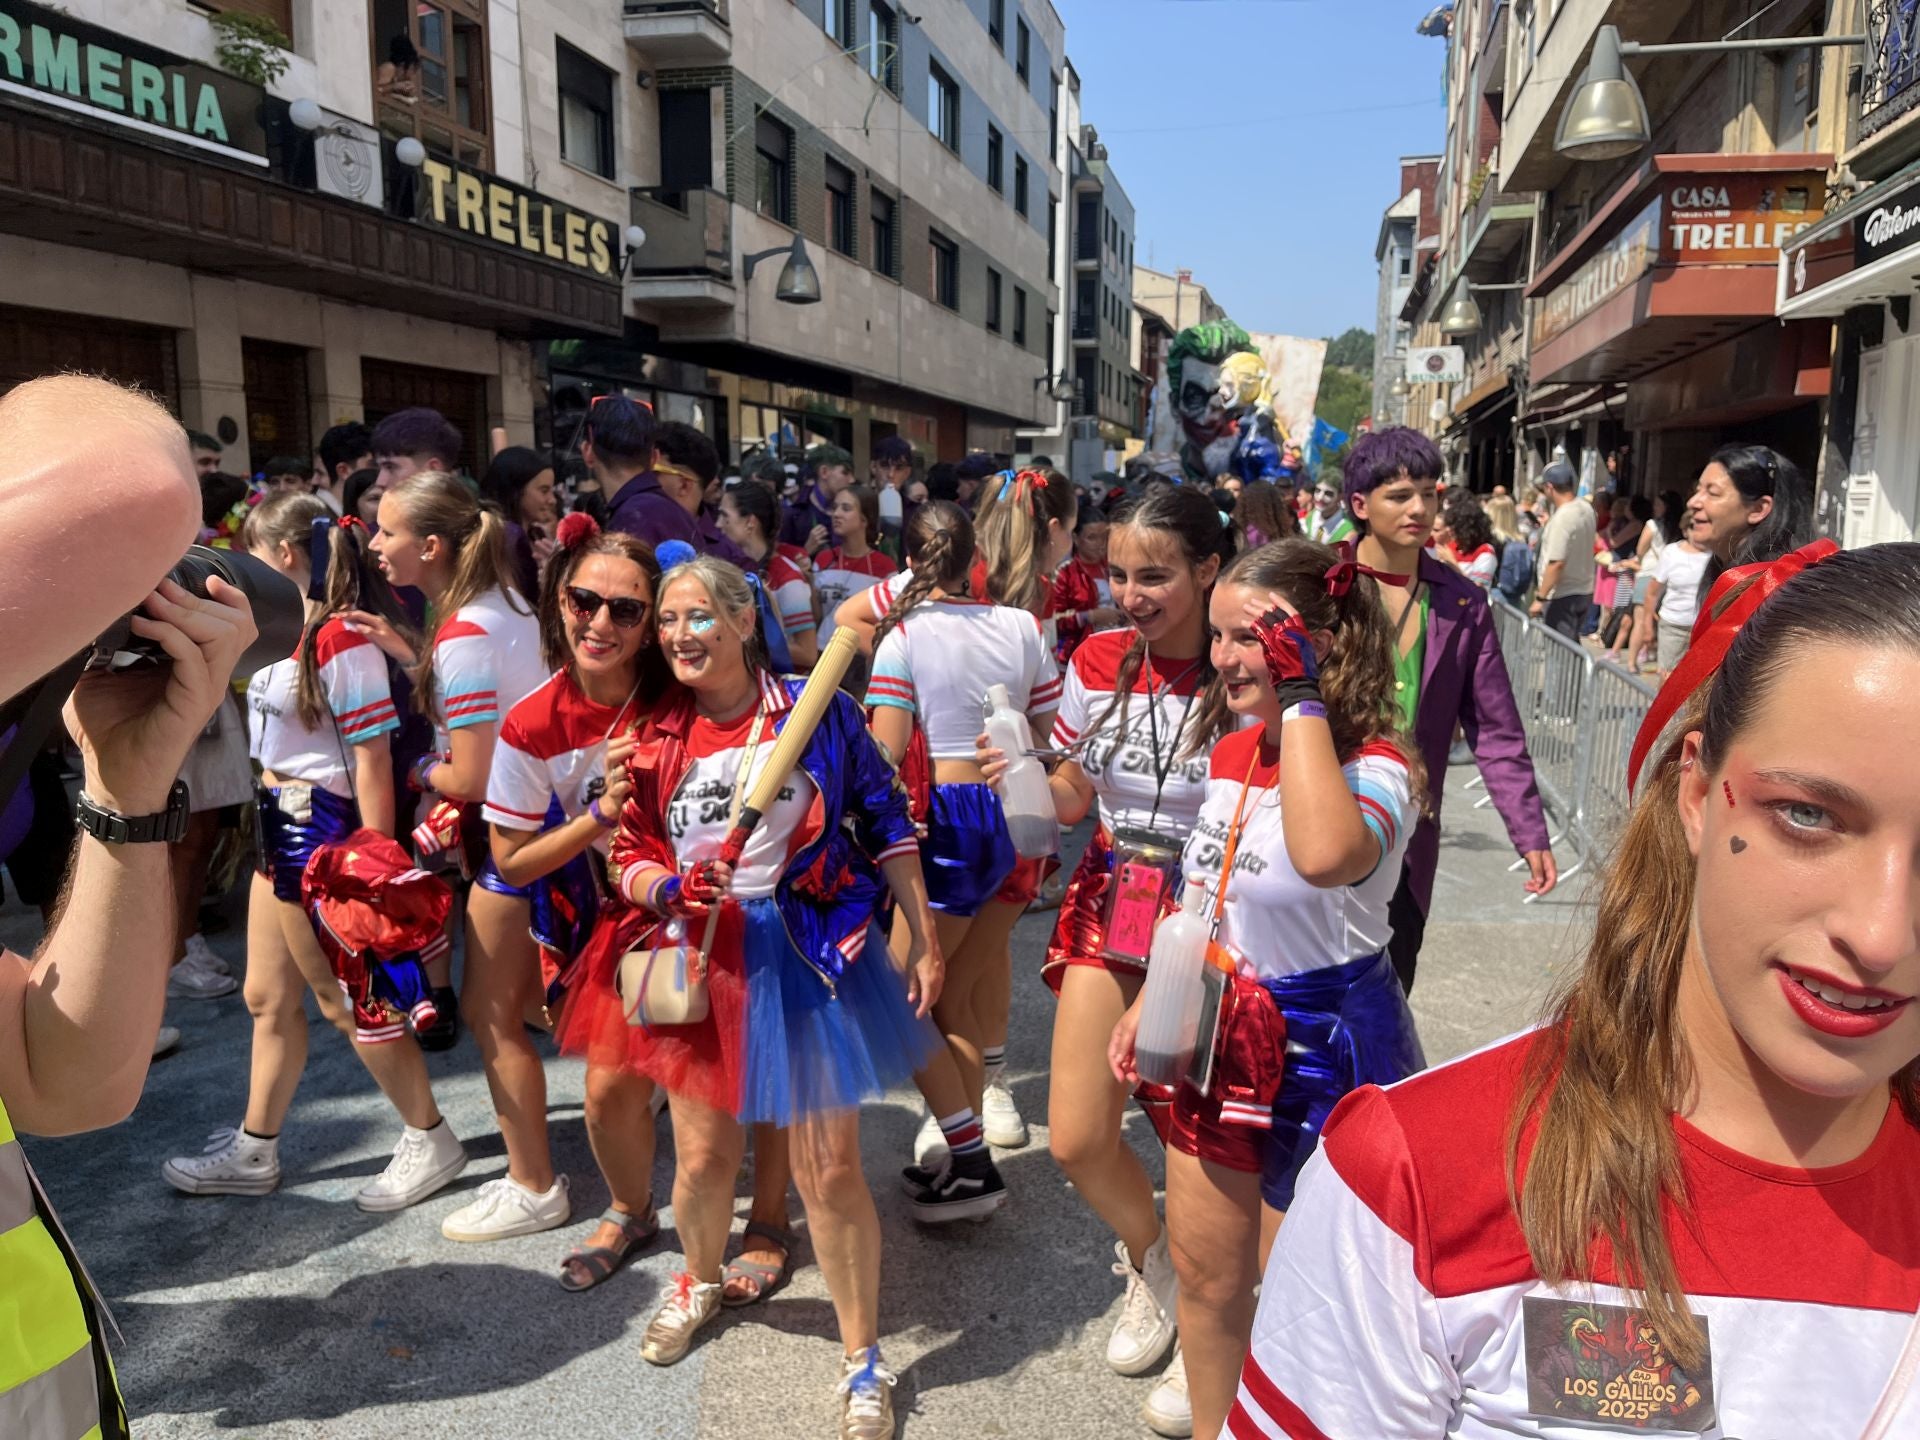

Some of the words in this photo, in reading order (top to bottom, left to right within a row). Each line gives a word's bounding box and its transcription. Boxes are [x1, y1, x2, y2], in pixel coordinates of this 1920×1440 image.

[1671, 186, 1731, 209] CASA
[423, 158, 611, 275] TRELLES
[1633, 1371, 1652, 1381] BAD
[1564, 1377, 1599, 1397] LOS
[1605, 1381, 1677, 1402] GALLOS
[1597, 1399, 1651, 1419] 2025
